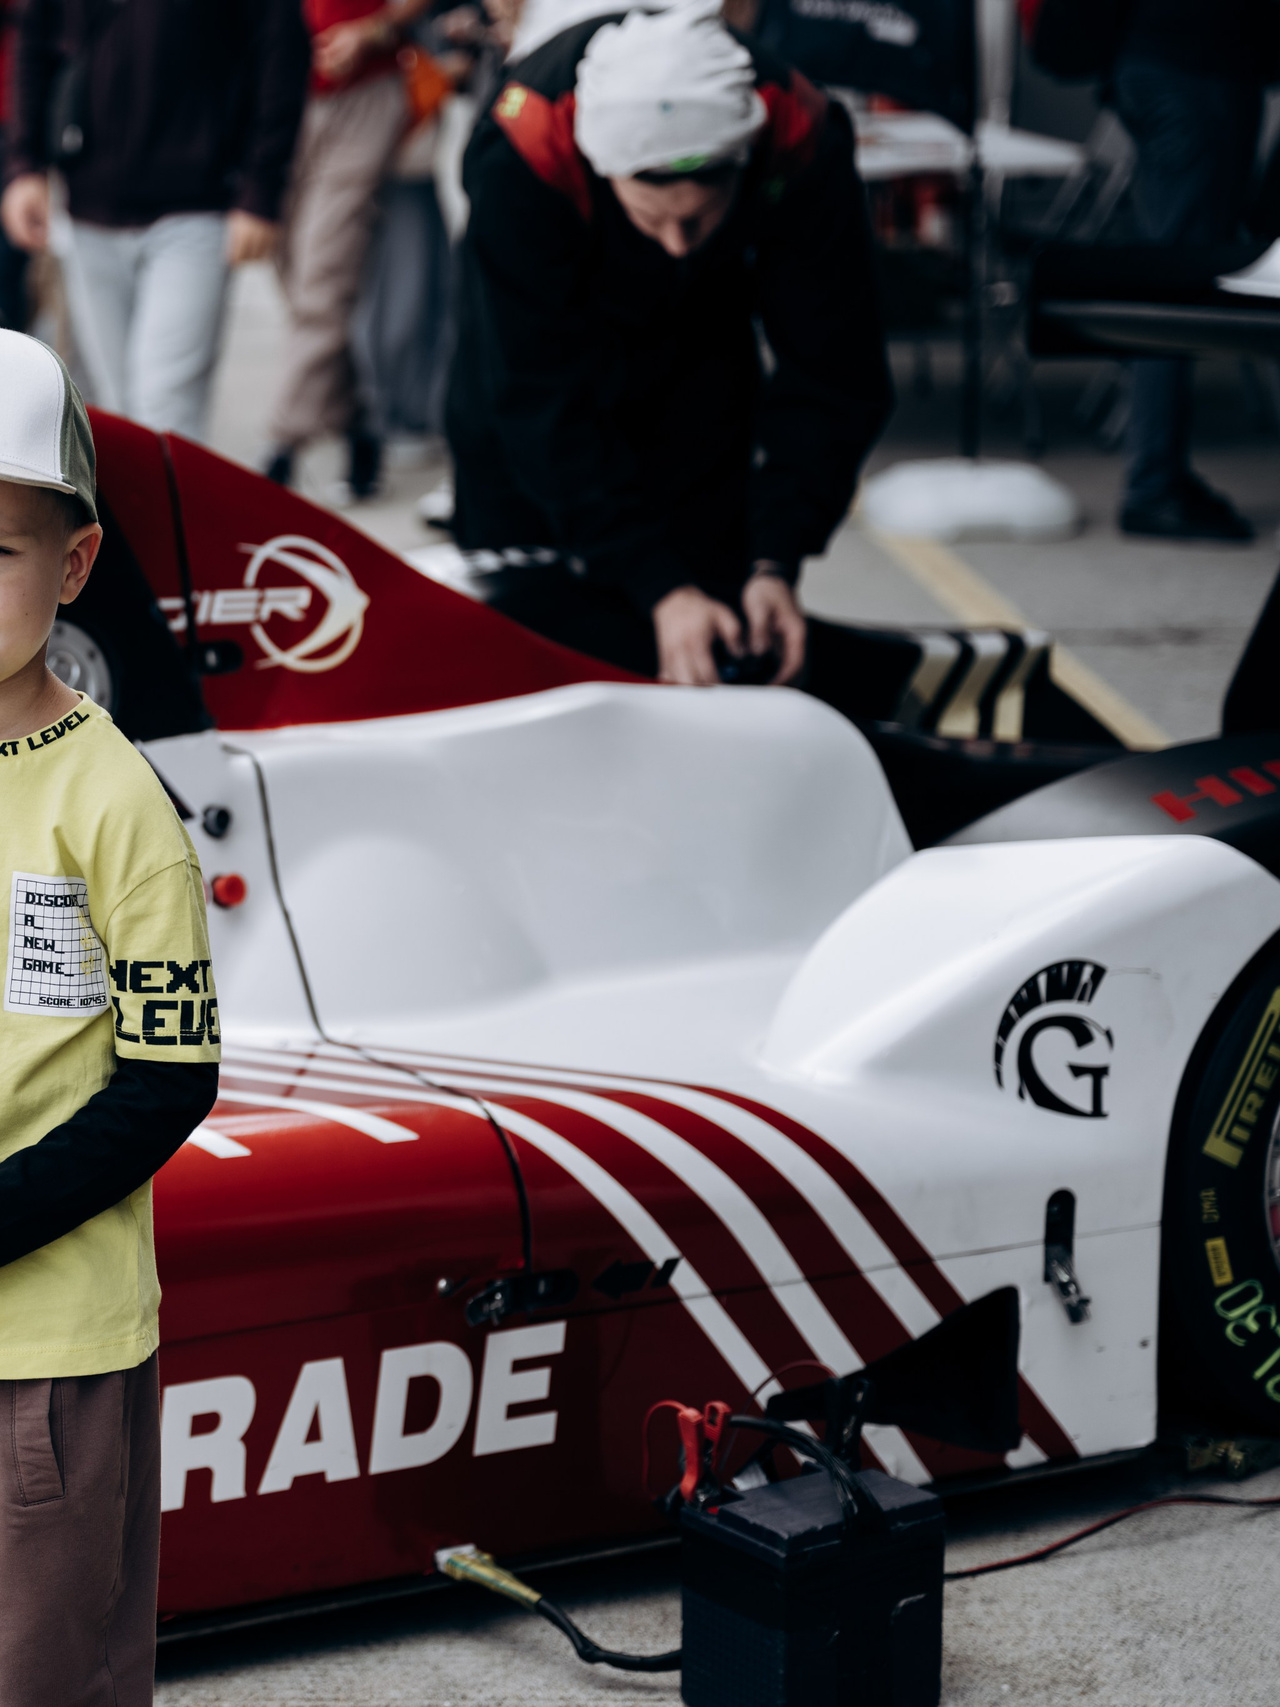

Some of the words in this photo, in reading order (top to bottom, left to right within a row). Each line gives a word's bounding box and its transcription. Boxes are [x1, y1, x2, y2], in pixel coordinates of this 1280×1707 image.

[27, 710, 90, 751] LEVEL
[1150, 757, 1280, 824] HI
[109, 960, 212, 993] NEXT
[39, 996, 76, 1007] SCORE:
[79, 995, 107, 1007] 107453
[111, 996, 221, 1045] LEVE
[161, 1320, 567, 1513] RADE
